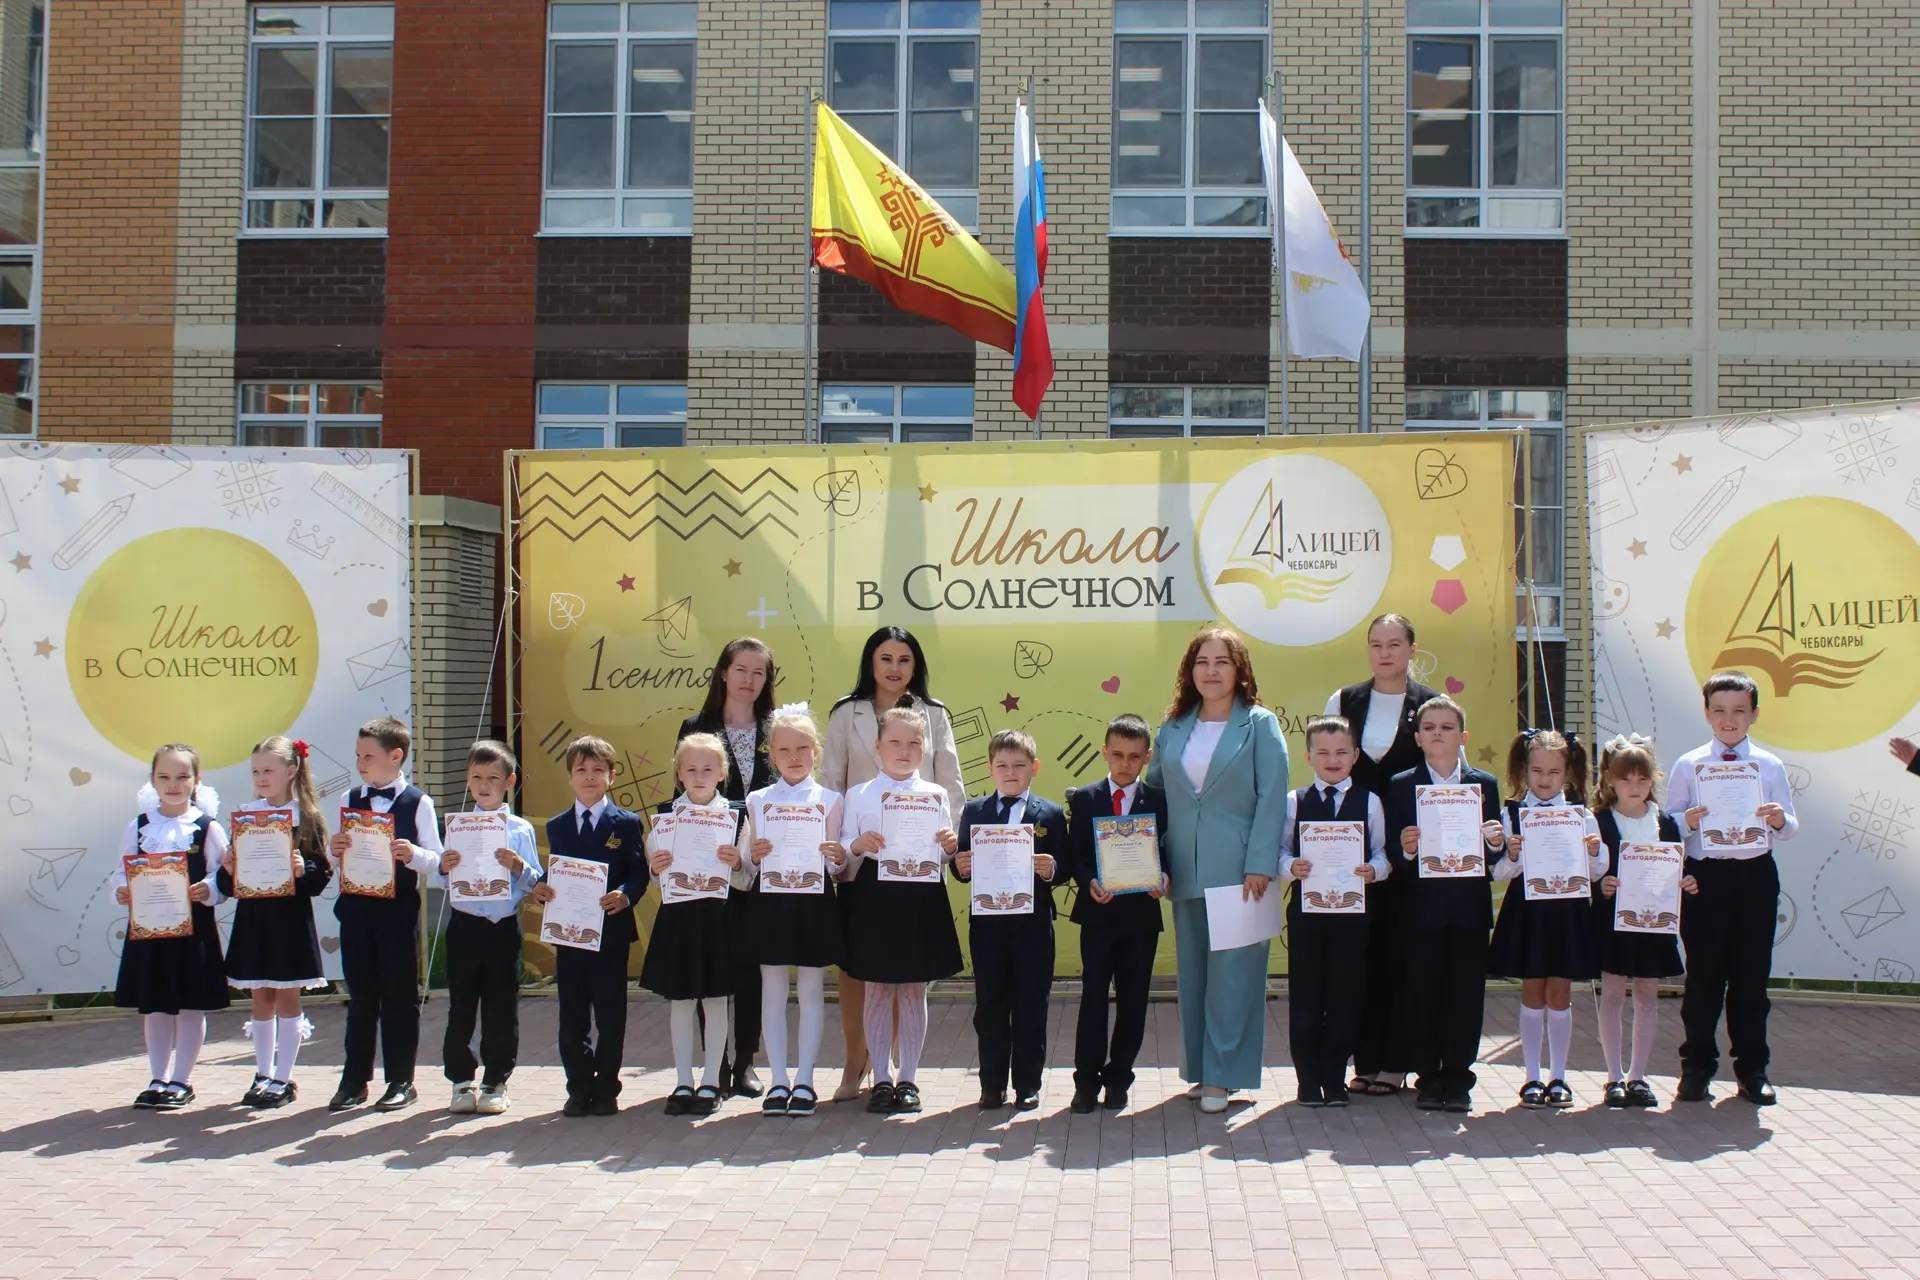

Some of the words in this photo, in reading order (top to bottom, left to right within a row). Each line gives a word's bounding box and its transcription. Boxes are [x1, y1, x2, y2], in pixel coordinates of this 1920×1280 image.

[950, 496, 1181, 566] Школа
[1287, 529, 1381, 556] ЛИЦЕЙ
[1287, 560, 1338, 571] ЧЕБОКСАРЫ
[856, 580, 884, 611] в
[902, 563, 1177, 612] Солнечном
[1800, 594, 1920, 630] ЛИЦЕЙ
[149, 604, 301, 649] Школа
[1800, 635, 1864, 649] ЧЕБОКСАРЫ
[84, 658, 103, 679] в
[116, 647, 299, 679] Солнечном
[1699, 774, 1757, 782] Благодарность
[884, 803, 939, 813] Благодарность
[1420, 798, 1478, 806] Благодарность
[678, 817, 733, 830] Благодарность
[766, 815, 822, 823] Благодарность
[1524, 820, 1581, 829] Благодарность
[450, 825, 505, 833] Благодарность
[974, 837, 1030, 846] Благодарность
[1622, 854, 1679, 864] Благодарность
[552, 868, 604, 883] Благодарность
